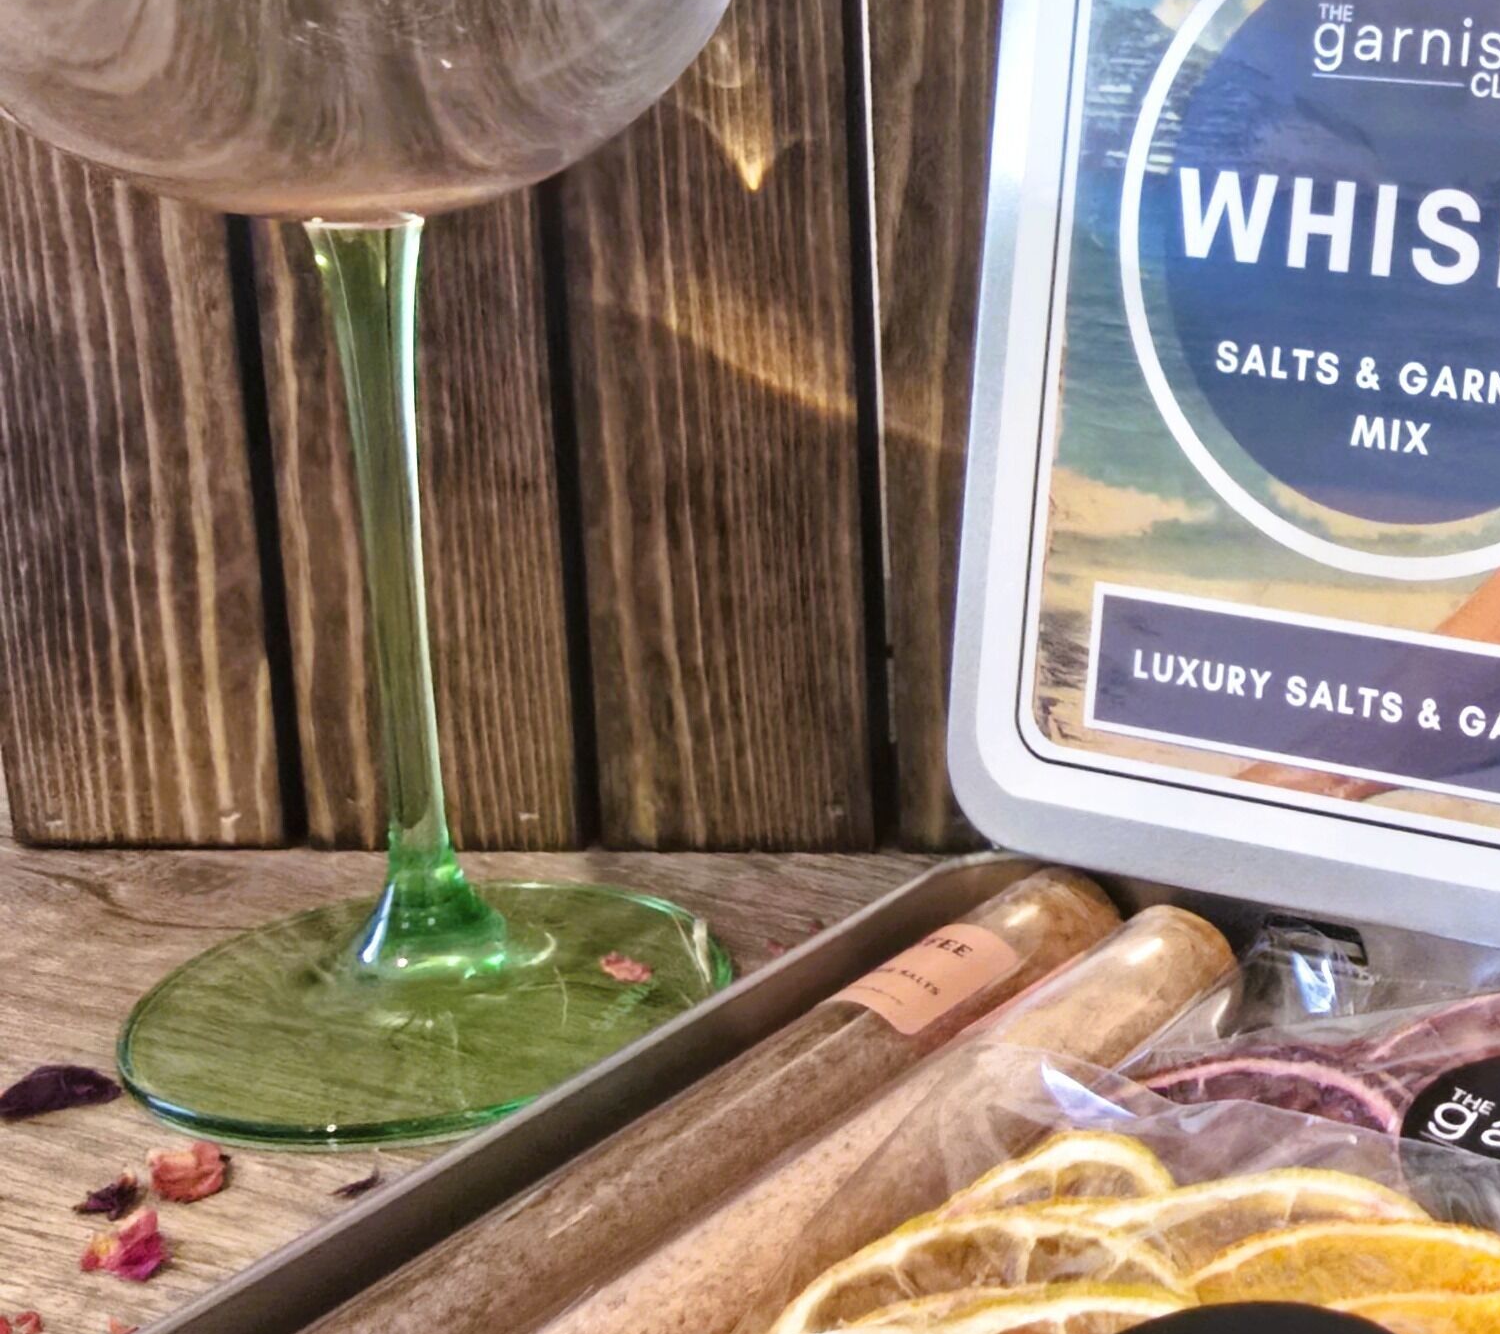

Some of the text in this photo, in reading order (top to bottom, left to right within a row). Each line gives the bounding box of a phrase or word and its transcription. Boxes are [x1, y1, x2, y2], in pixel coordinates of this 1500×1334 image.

[1318, 2, 1354, 24] THE
[1215, 340, 1341, 385] SALTS
[1356, 357, 1381, 391] &
[1350, 414, 1431, 456] MIX
[1132, 648, 1272, 699] LUXURY
[1286, 676, 1402, 723] SALTS
[1418, 698, 1441, 730] &
[1453, 1087, 1495, 1115] THE
